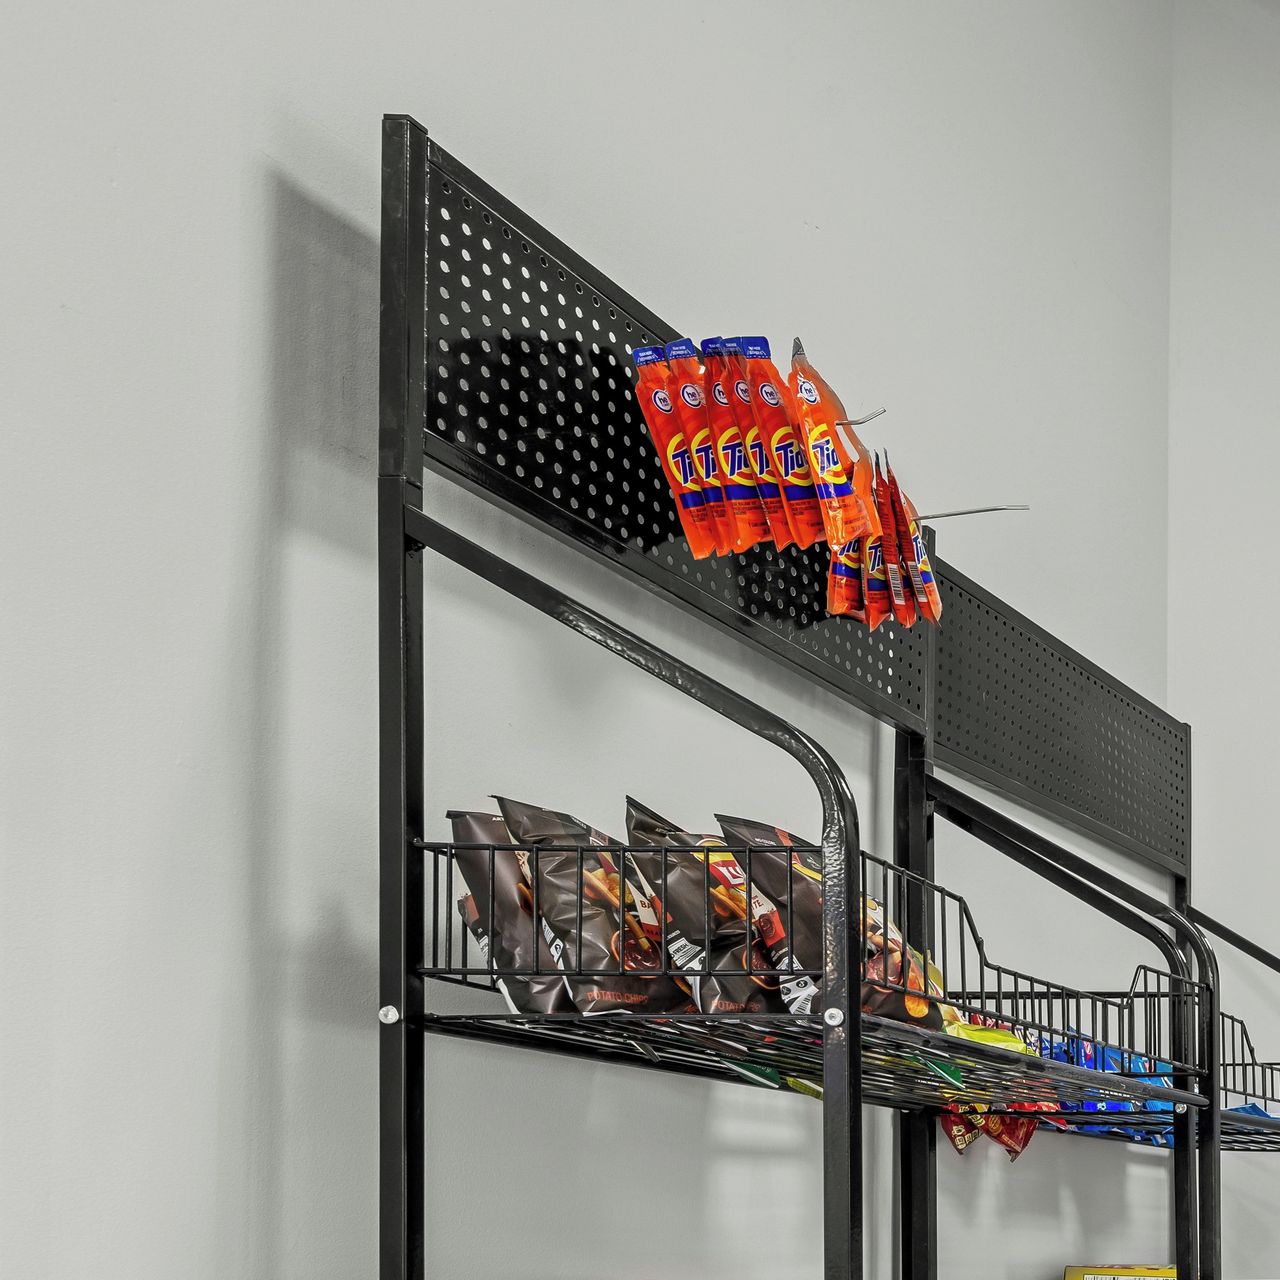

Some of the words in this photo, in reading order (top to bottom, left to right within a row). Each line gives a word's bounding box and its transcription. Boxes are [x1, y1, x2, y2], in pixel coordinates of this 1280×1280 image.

[671, 447, 694, 486] Ti
[695, 443, 717, 481] Ti
[812, 437, 839, 476] Tid
[587, 990, 622, 1002] POTATO
[624, 993, 649, 1004] CHIPS
